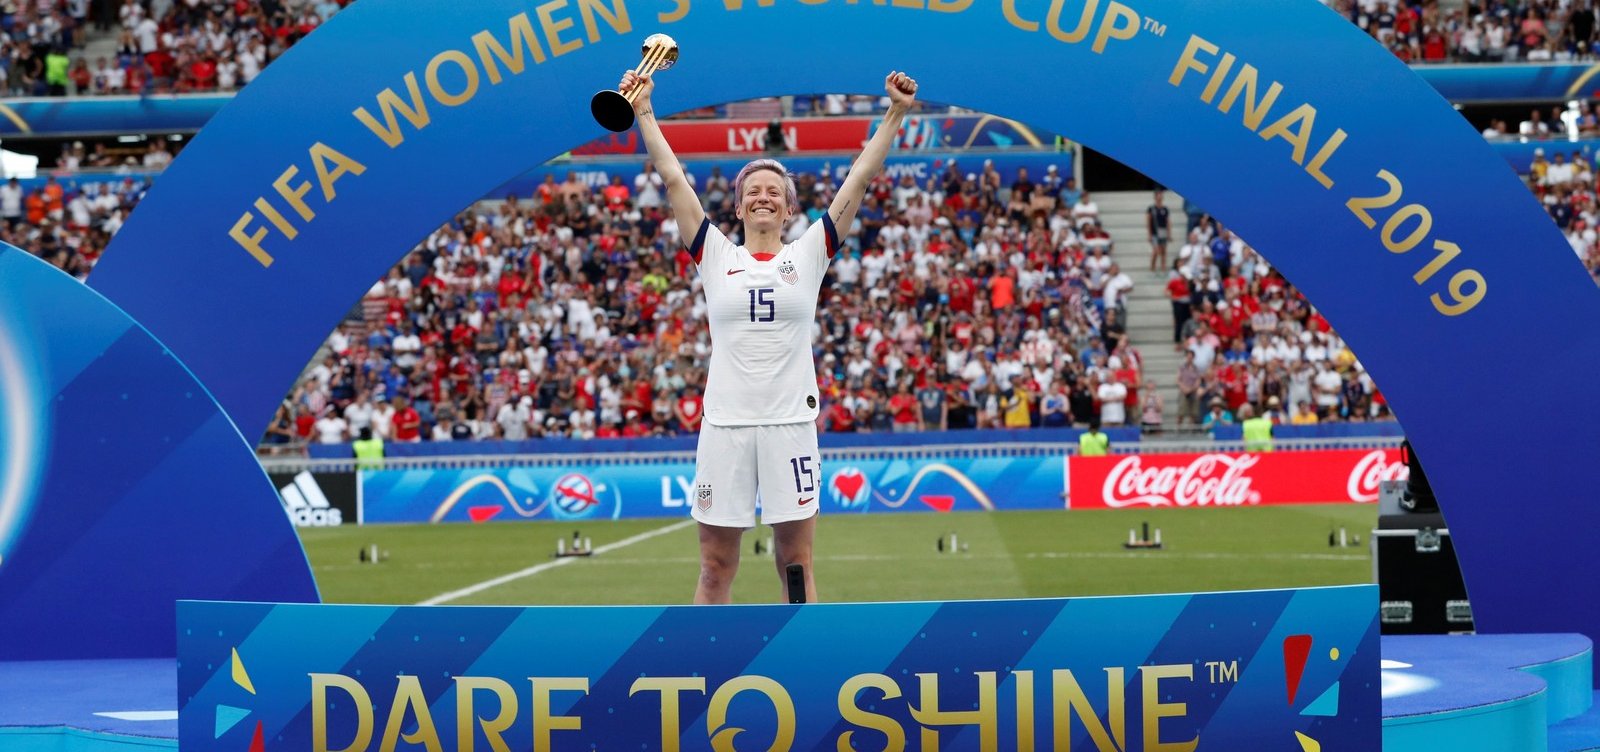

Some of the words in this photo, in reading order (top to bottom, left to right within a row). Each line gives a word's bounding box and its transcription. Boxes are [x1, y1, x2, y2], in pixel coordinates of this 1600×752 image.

[229, 142, 366, 267] FIFA
[1168, 35, 1347, 189] FINAL
[1346, 169, 1487, 316] 2019
[749, 289, 775, 322] 15
[790, 456, 814, 493] 15
[308, 672, 590, 752] DARE
[629, 675, 797, 752] TO
